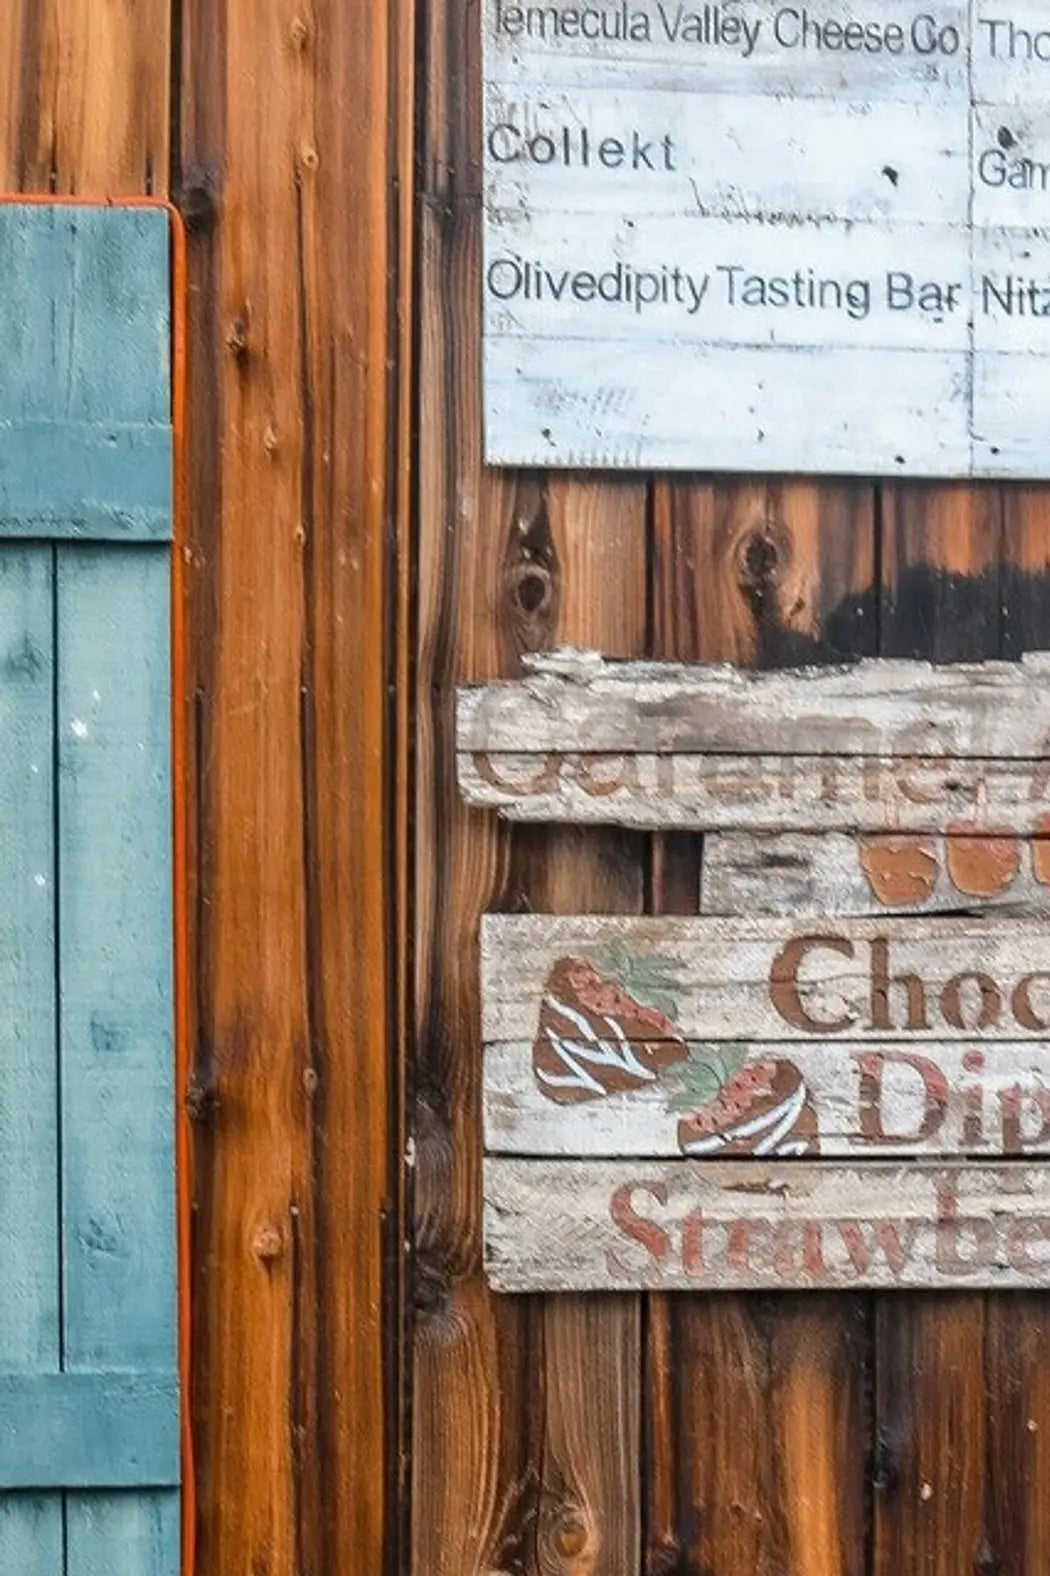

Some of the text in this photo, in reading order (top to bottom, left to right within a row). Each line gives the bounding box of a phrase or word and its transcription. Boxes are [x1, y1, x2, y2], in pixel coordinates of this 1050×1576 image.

[658, 2, 761, 57] Valley
[773, 9, 904, 55] Cheese
[911, 14, 960, 56] Co
[487, 123, 677, 172] Collekt
[486, 258, 962, 320] Olivedipity Tasting Bar
